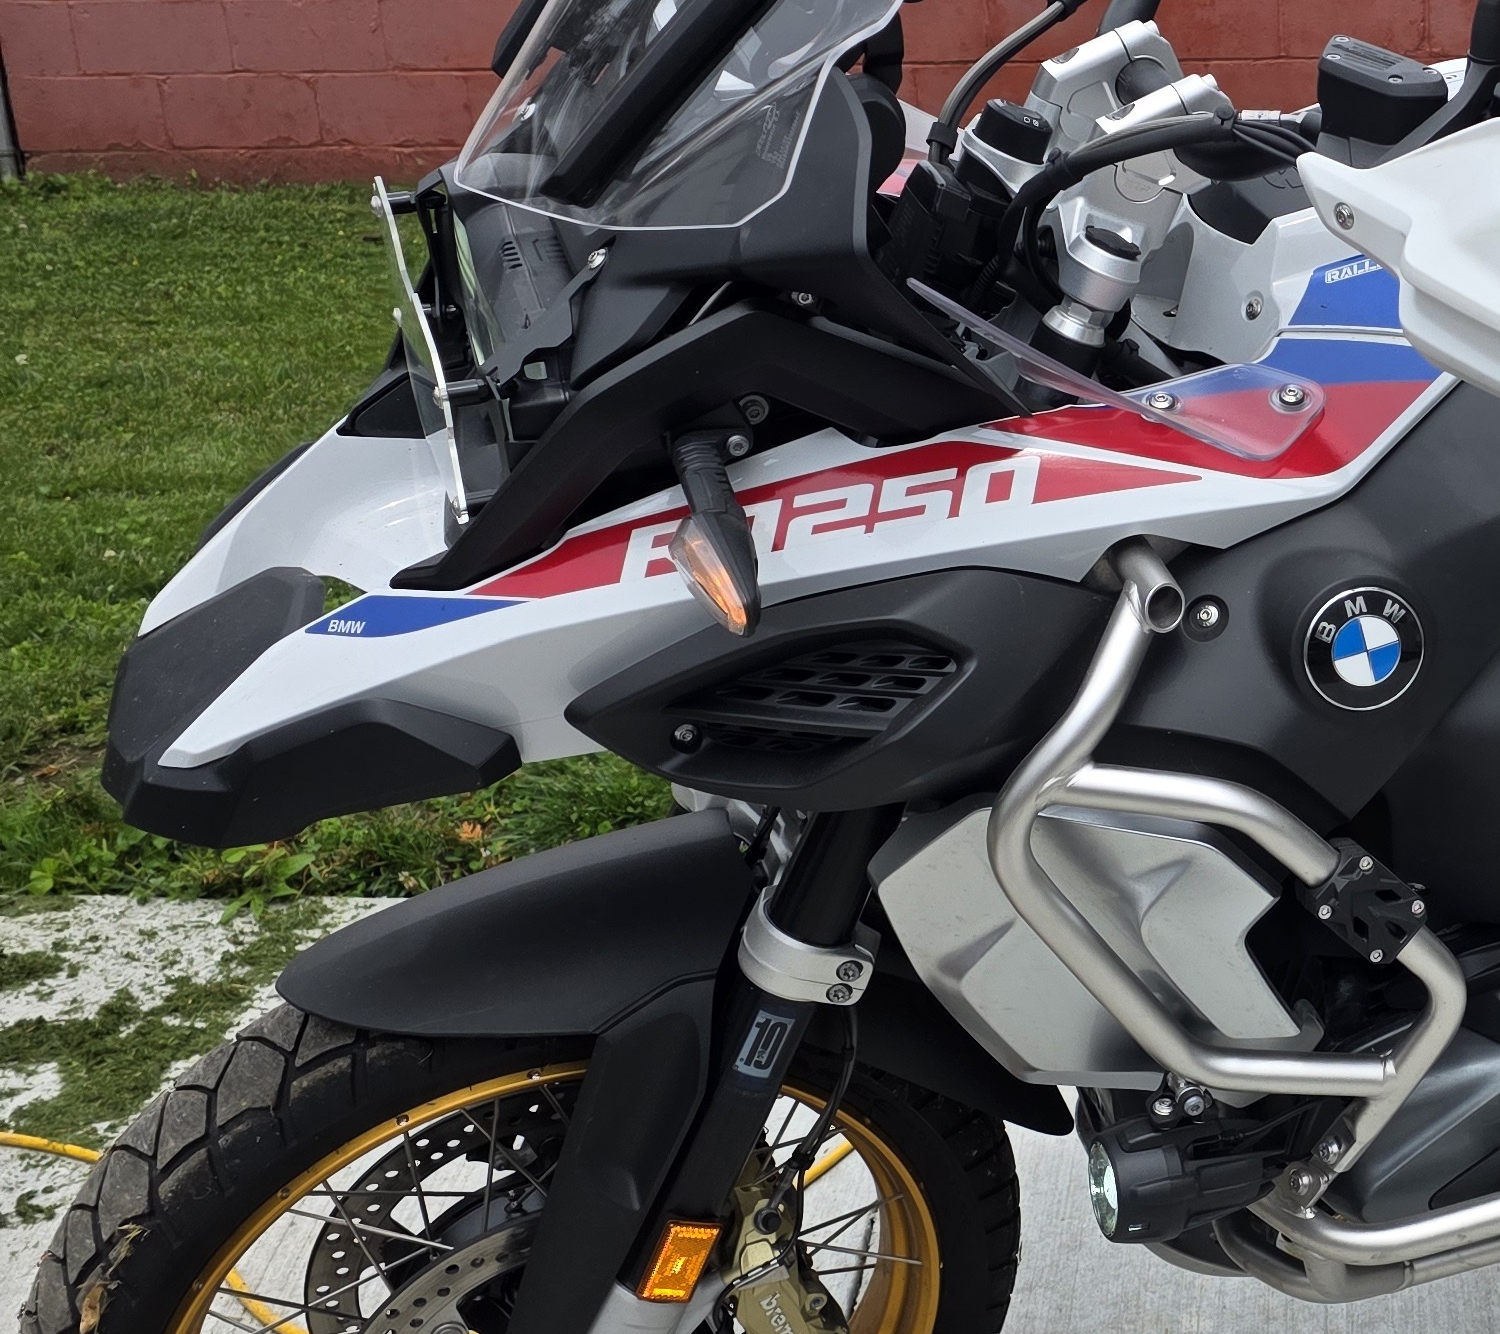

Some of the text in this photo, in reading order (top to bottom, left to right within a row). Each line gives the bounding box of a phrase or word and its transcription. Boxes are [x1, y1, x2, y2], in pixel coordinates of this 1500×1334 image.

[1326, 259, 1382, 283] RALL
[327, 619, 366, 634] BMW
[1314, 595, 1407, 644] BMW
